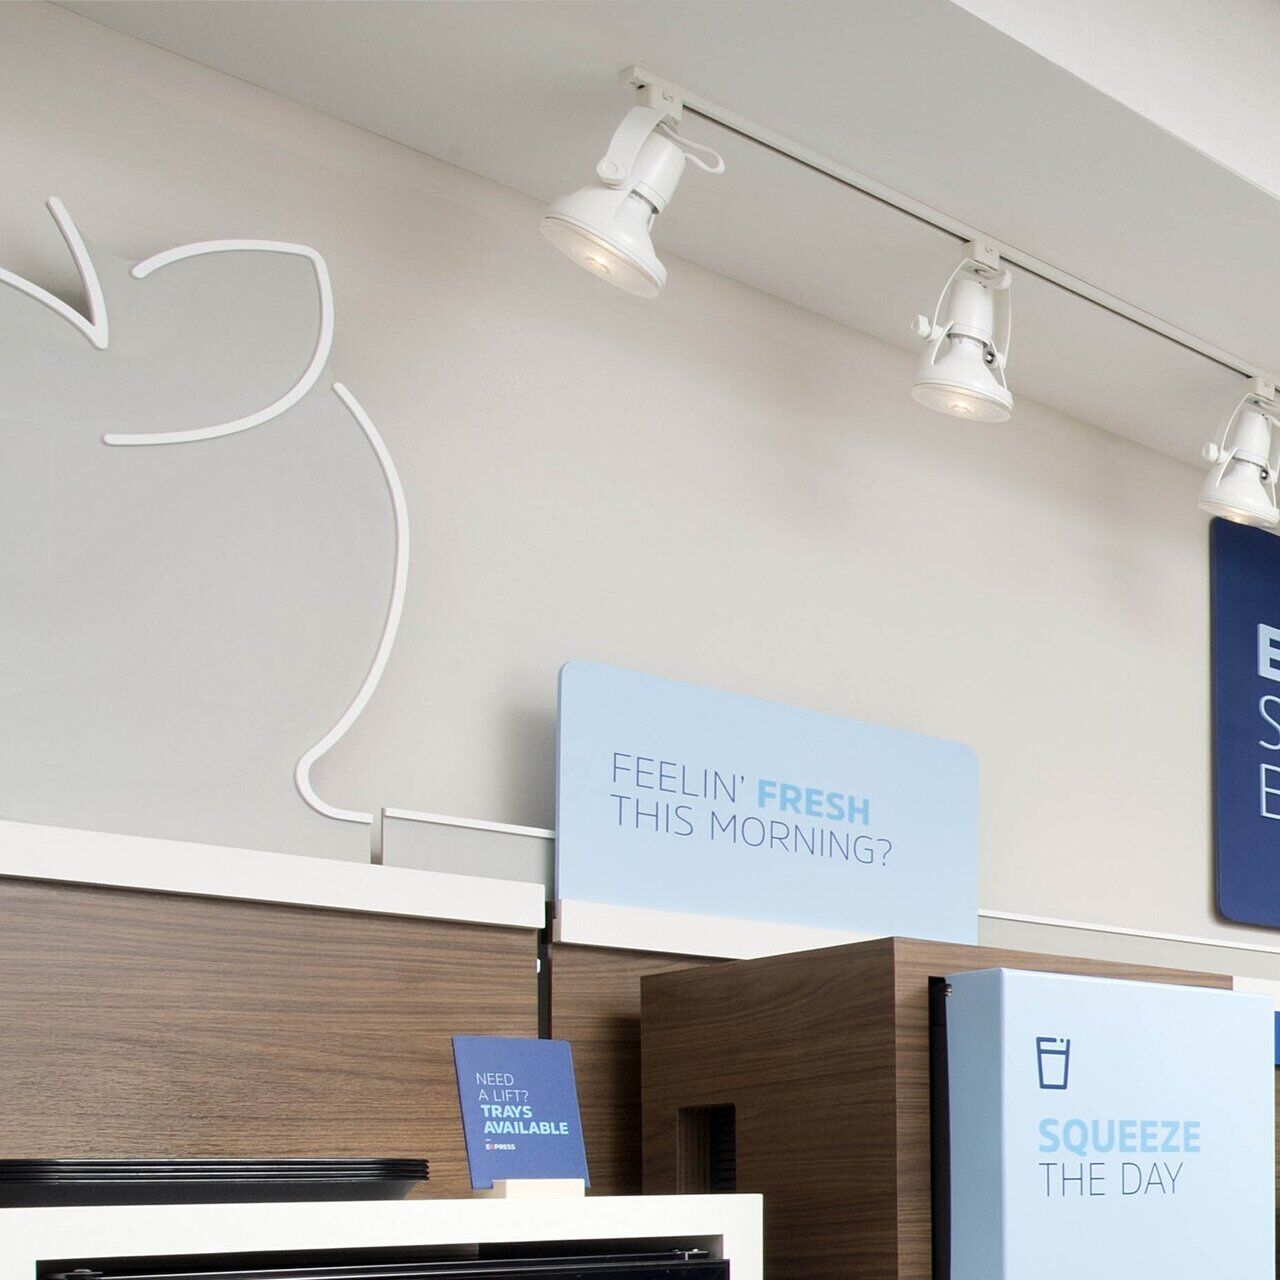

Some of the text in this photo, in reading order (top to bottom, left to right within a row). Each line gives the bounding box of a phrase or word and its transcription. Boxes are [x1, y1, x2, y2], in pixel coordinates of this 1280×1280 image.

[612, 751, 870, 826] FEELIN' FRESH
[610, 794, 893, 867] THIS MORNING?
[475, 1072, 515, 1087] NEED
[478, 1088, 529, 1103] A LIFT?
[480, 1104, 534, 1119] TRAYS
[483, 1120, 570, 1135] AVAILABLE
[1038, 1117, 1201, 1157] SQUEEZE
[1038, 1161, 1184, 1197] THE DAY
